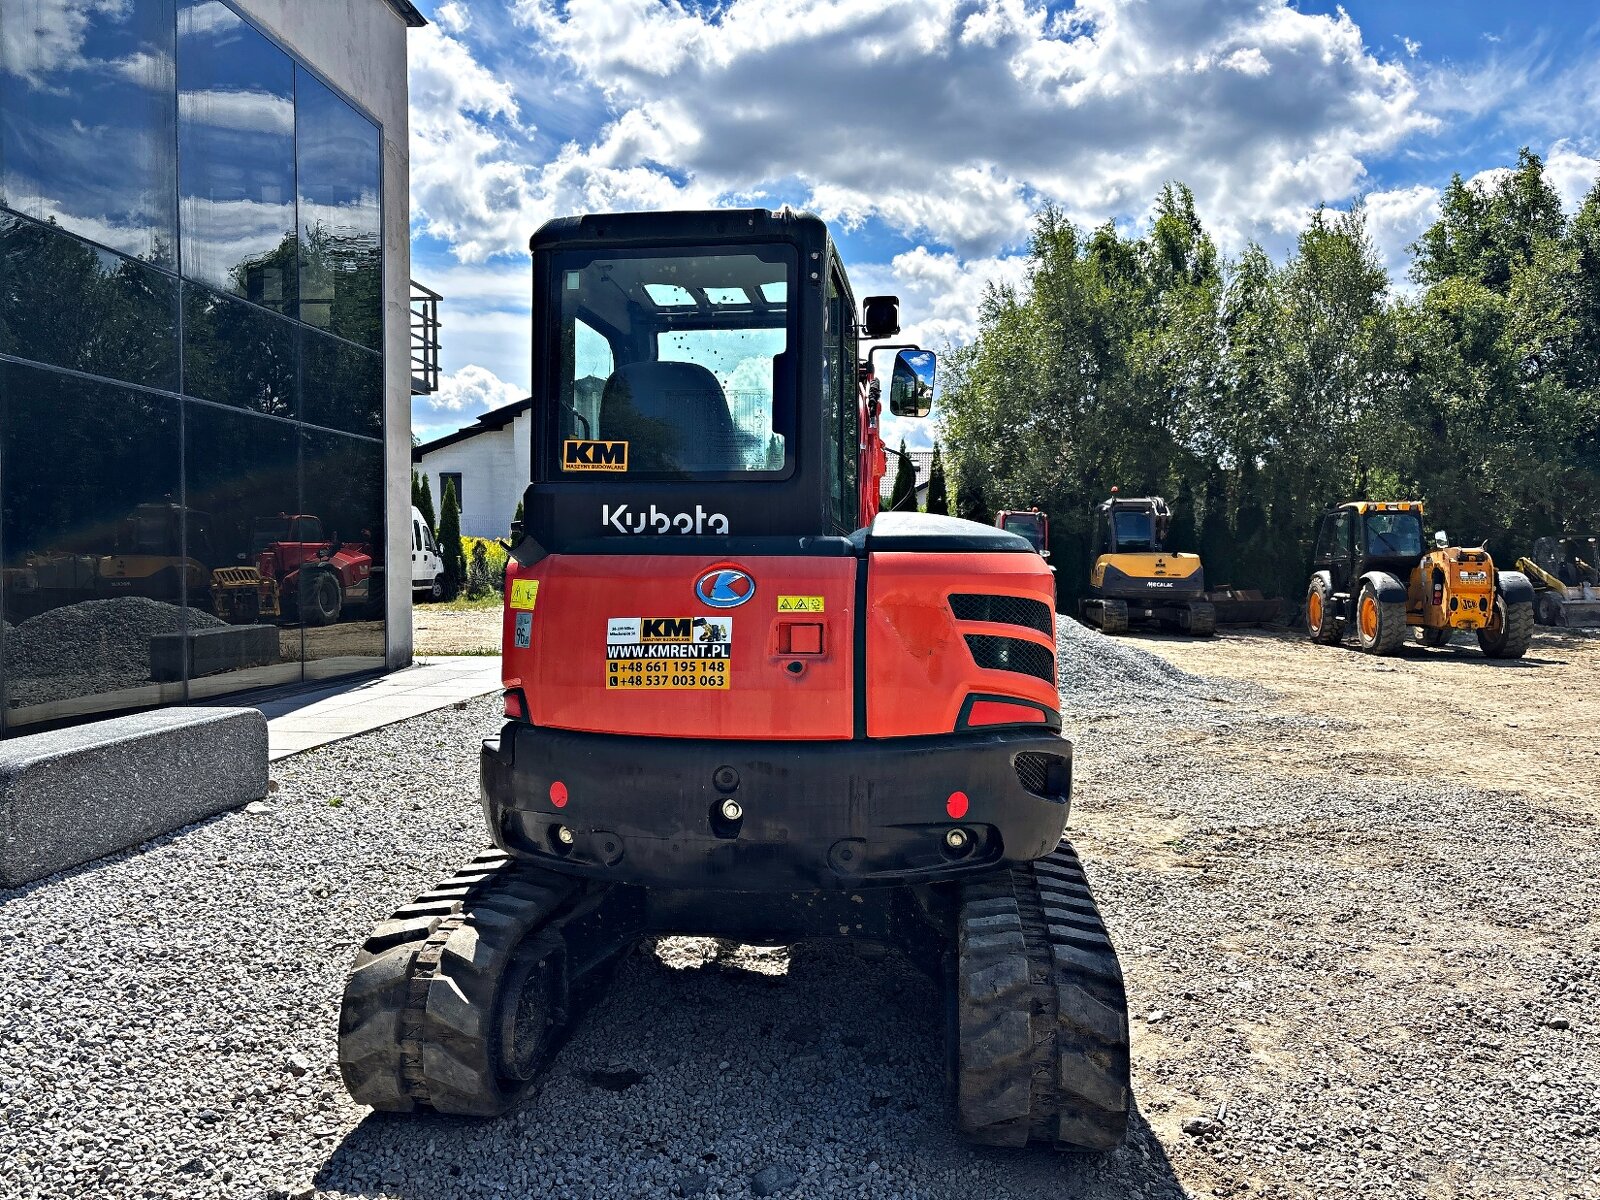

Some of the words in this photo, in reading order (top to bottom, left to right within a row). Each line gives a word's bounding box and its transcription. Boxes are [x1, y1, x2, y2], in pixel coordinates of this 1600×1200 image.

[566, 442, 625, 464] KM
[602, 504, 729, 534] Kubota
[642, 619, 691, 637] KM
[607, 645, 729, 658] WWW.KMRENT.PL
[620, 662, 642, 672] +48
[645, 662, 668, 672] 661
[673, 662, 696, 672] 195
[701, 662, 725, 672] 148
[620, 676, 642, 686] +48
[645, 676, 668, 686] 537
[672, 676, 696, 686] 003
[700, 676, 724, 686] 063
